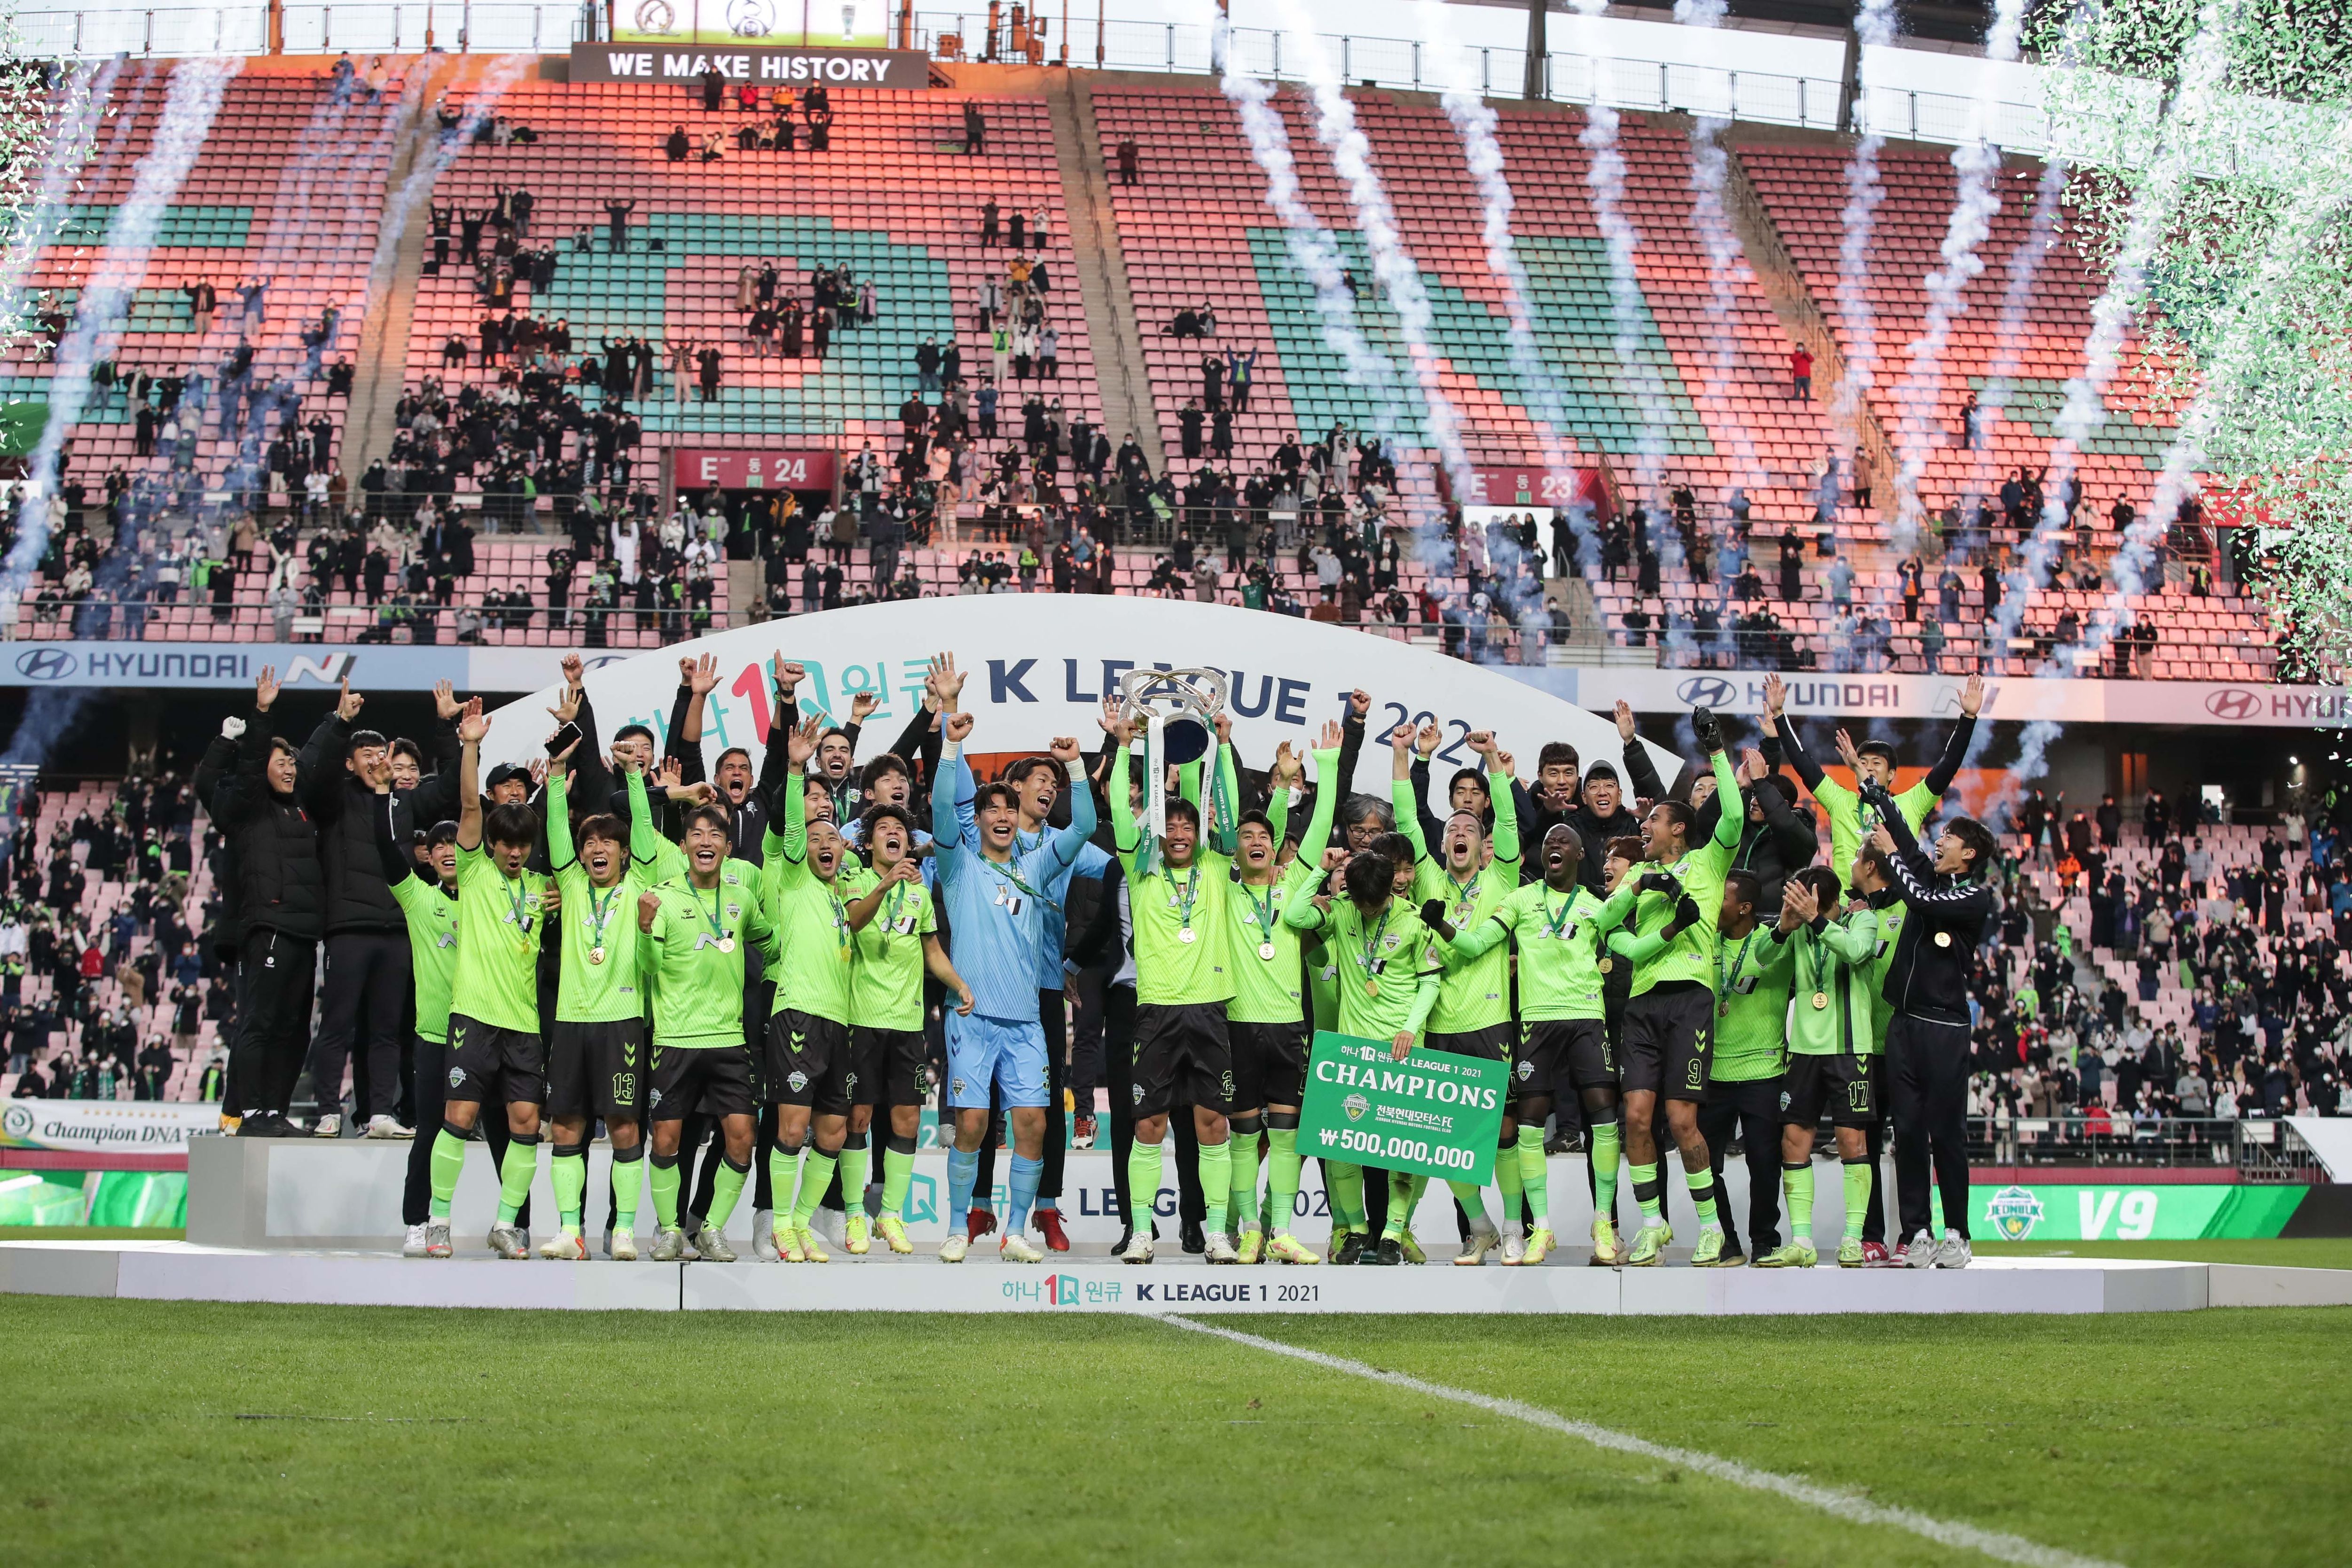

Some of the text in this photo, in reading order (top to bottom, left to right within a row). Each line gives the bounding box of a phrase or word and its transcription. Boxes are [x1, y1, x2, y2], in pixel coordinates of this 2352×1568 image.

[608, 53, 891, 82] WE MAKE HISTORY
[701, 457, 718, 480] E
[775, 459, 807, 482] 24
[1471, 474, 1487, 497] E
[1541, 475, 1572, 499] 23
[89, 652, 248, 678] HYUNDAI
[985, 659, 1039, 704] K
[1748, 682, 1899, 707] HUNDAI
[1341, 1046, 1359, 1057] 하나
[1360, 1046, 1375, 1062] 1Q
[1400, 1057, 1408, 1066] K
[1411, 1058, 1450, 1073] LEAGUE
[1462, 1067, 1481, 1078] 2021
[1688, 1058, 1702, 1084] 9
[613, 1073, 635, 1099] 13
[1317, 1061, 1497, 1110] CHAMPIONS
[1848, 1081, 1869, 1106] 17
[1342, 1099, 1370, 1111] JEONBUK
[44, 1121, 137, 1145] Champion
[141, 1127, 181, 1143] DNA
[903, 1172, 939, 1224] Q
[2078, 1191, 2157, 1240] V9
[1002, 1274, 1319, 1305] 하나 1Q 원큐 K LEAGUE 1 2021
